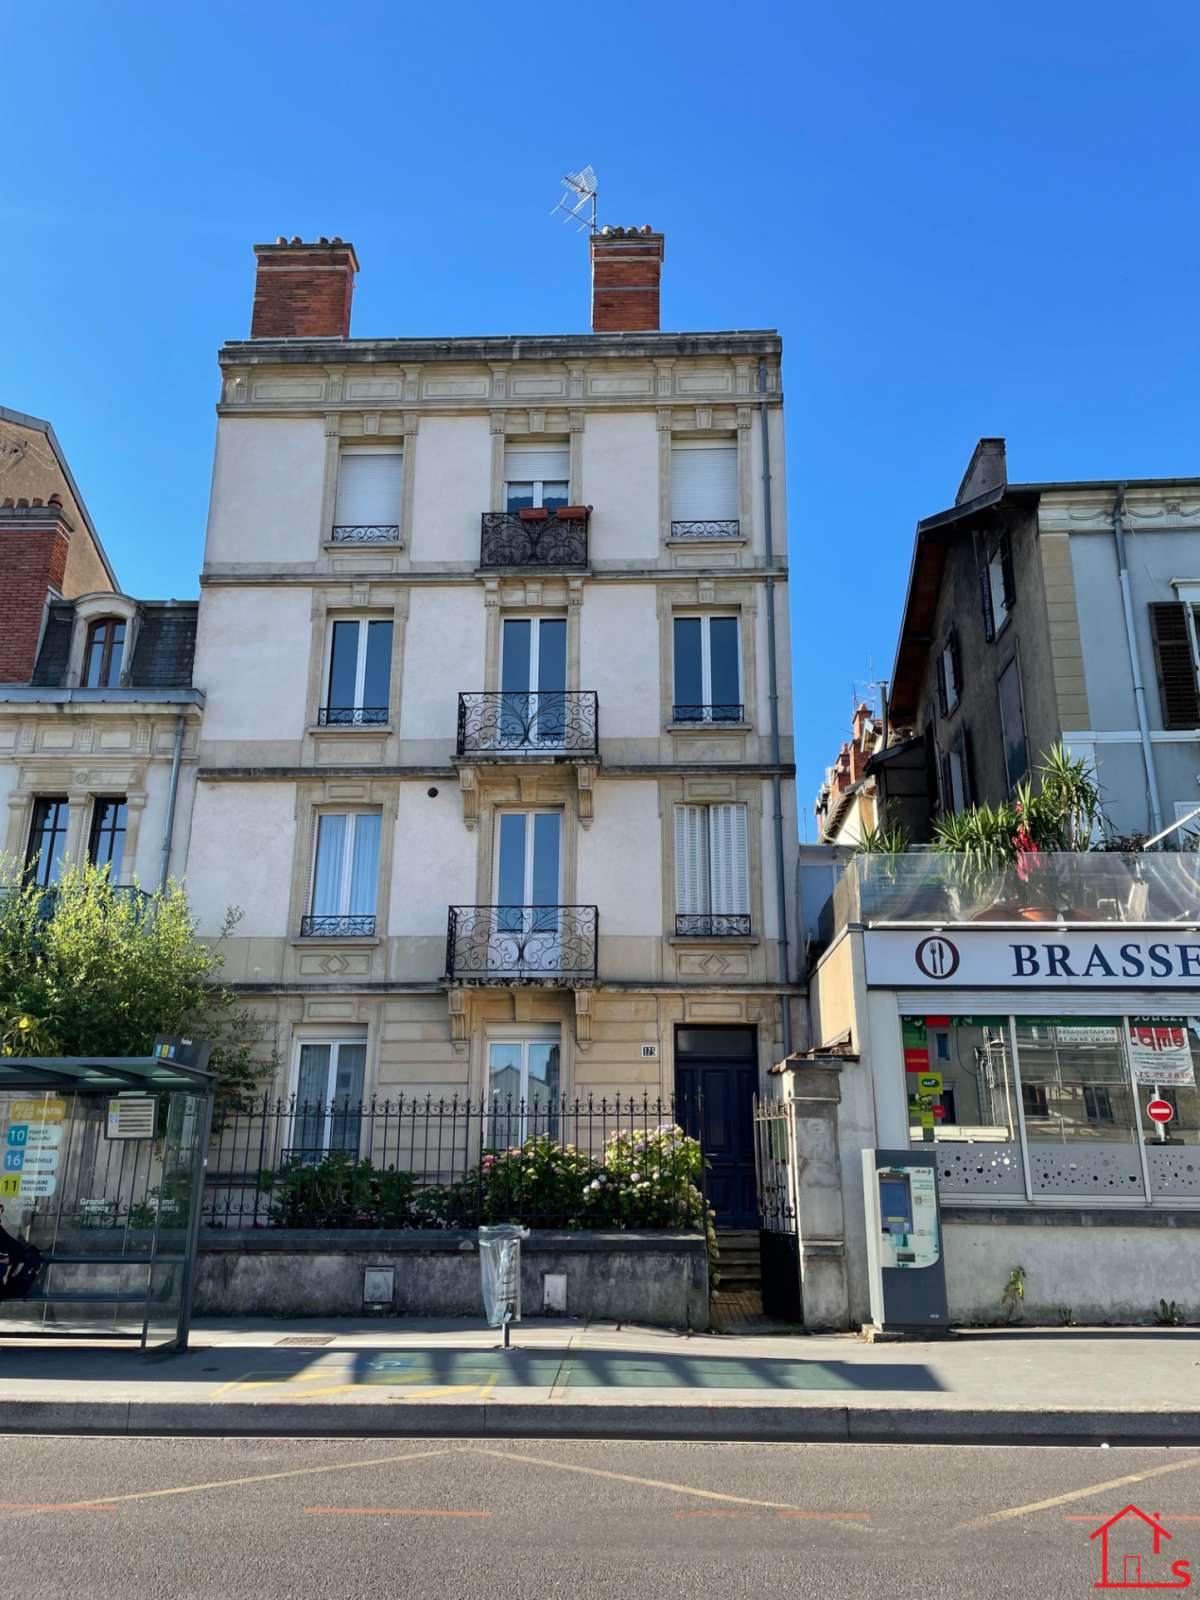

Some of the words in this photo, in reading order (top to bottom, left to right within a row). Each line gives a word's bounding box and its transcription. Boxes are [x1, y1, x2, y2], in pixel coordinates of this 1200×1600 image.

[1009, 943, 1200, 977] BRASSE
[9, 1129, 25, 1140] 10
[7, 1154, 21, 1166] 16
[4, 1180, 17, 1191] 11
